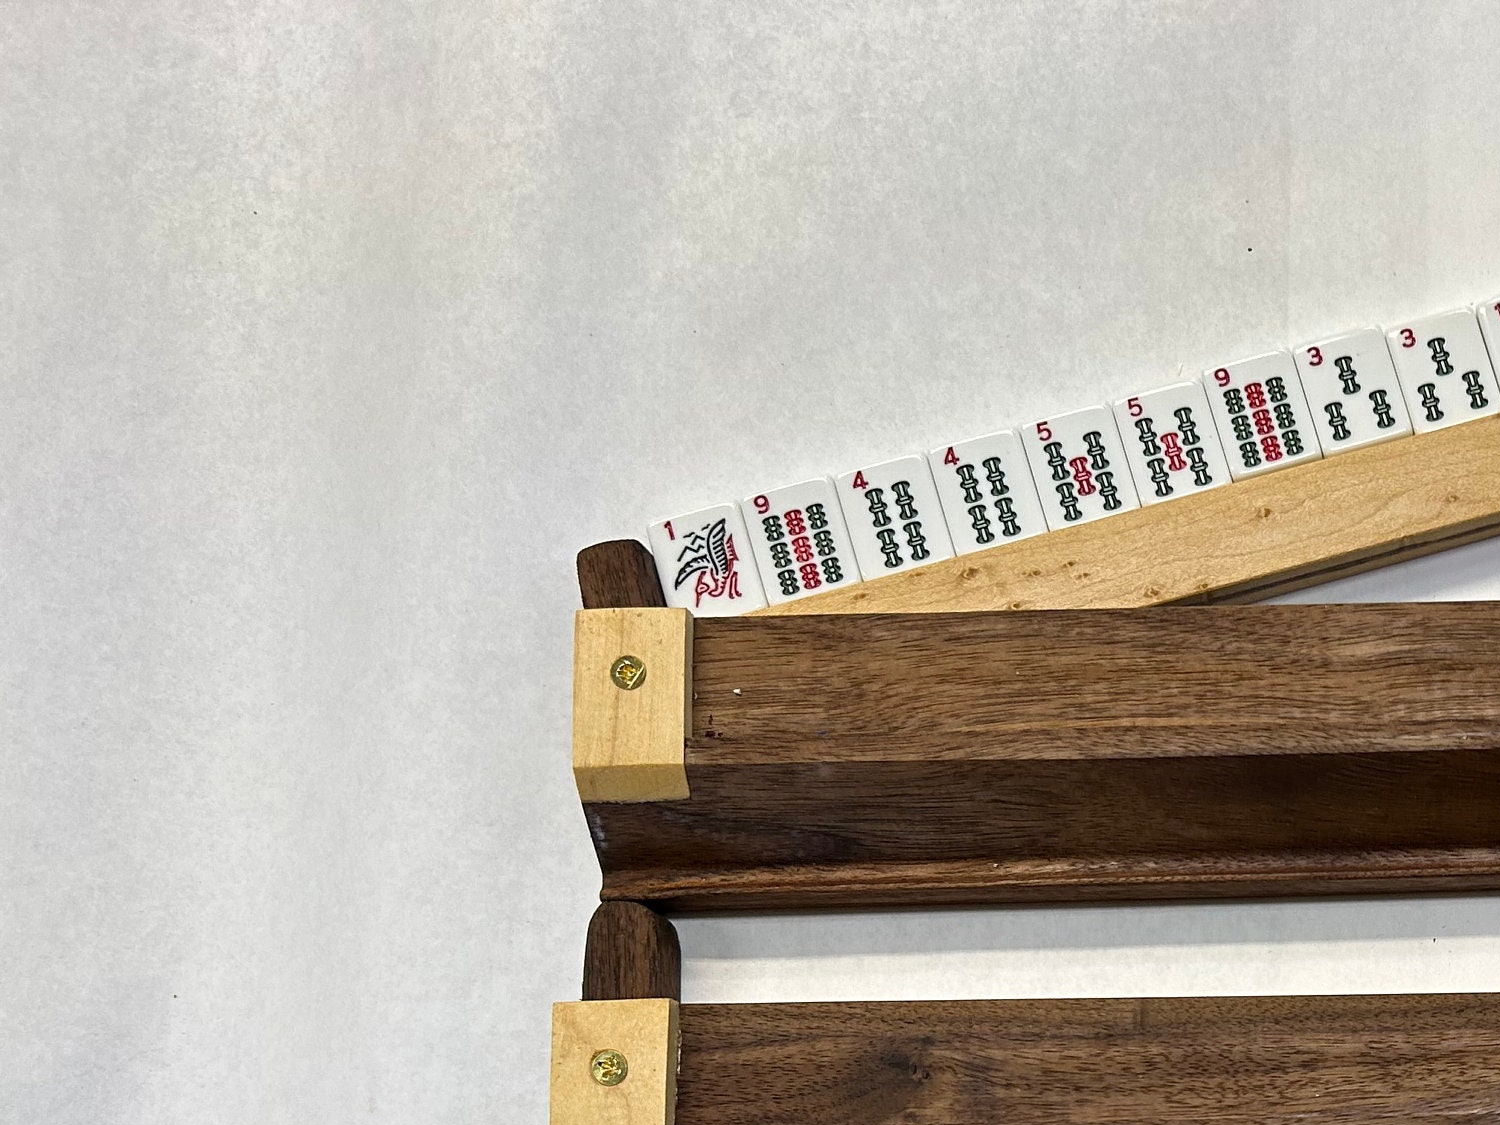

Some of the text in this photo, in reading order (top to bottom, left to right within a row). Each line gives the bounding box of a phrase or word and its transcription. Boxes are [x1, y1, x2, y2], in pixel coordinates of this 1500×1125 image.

[1401, 327, 1417, 349] 3
[1308, 346, 1324, 367] 3
[1213, 367, 1231, 388] 9
[1126, 397, 1144, 418] 5
[1035, 421, 1053, 442] 5
[943, 447, 959, 465] 4
[852, 471, 868, 489] 4
[752, 494, 770, 515] 9
[663, 521, 676, 541] 1
